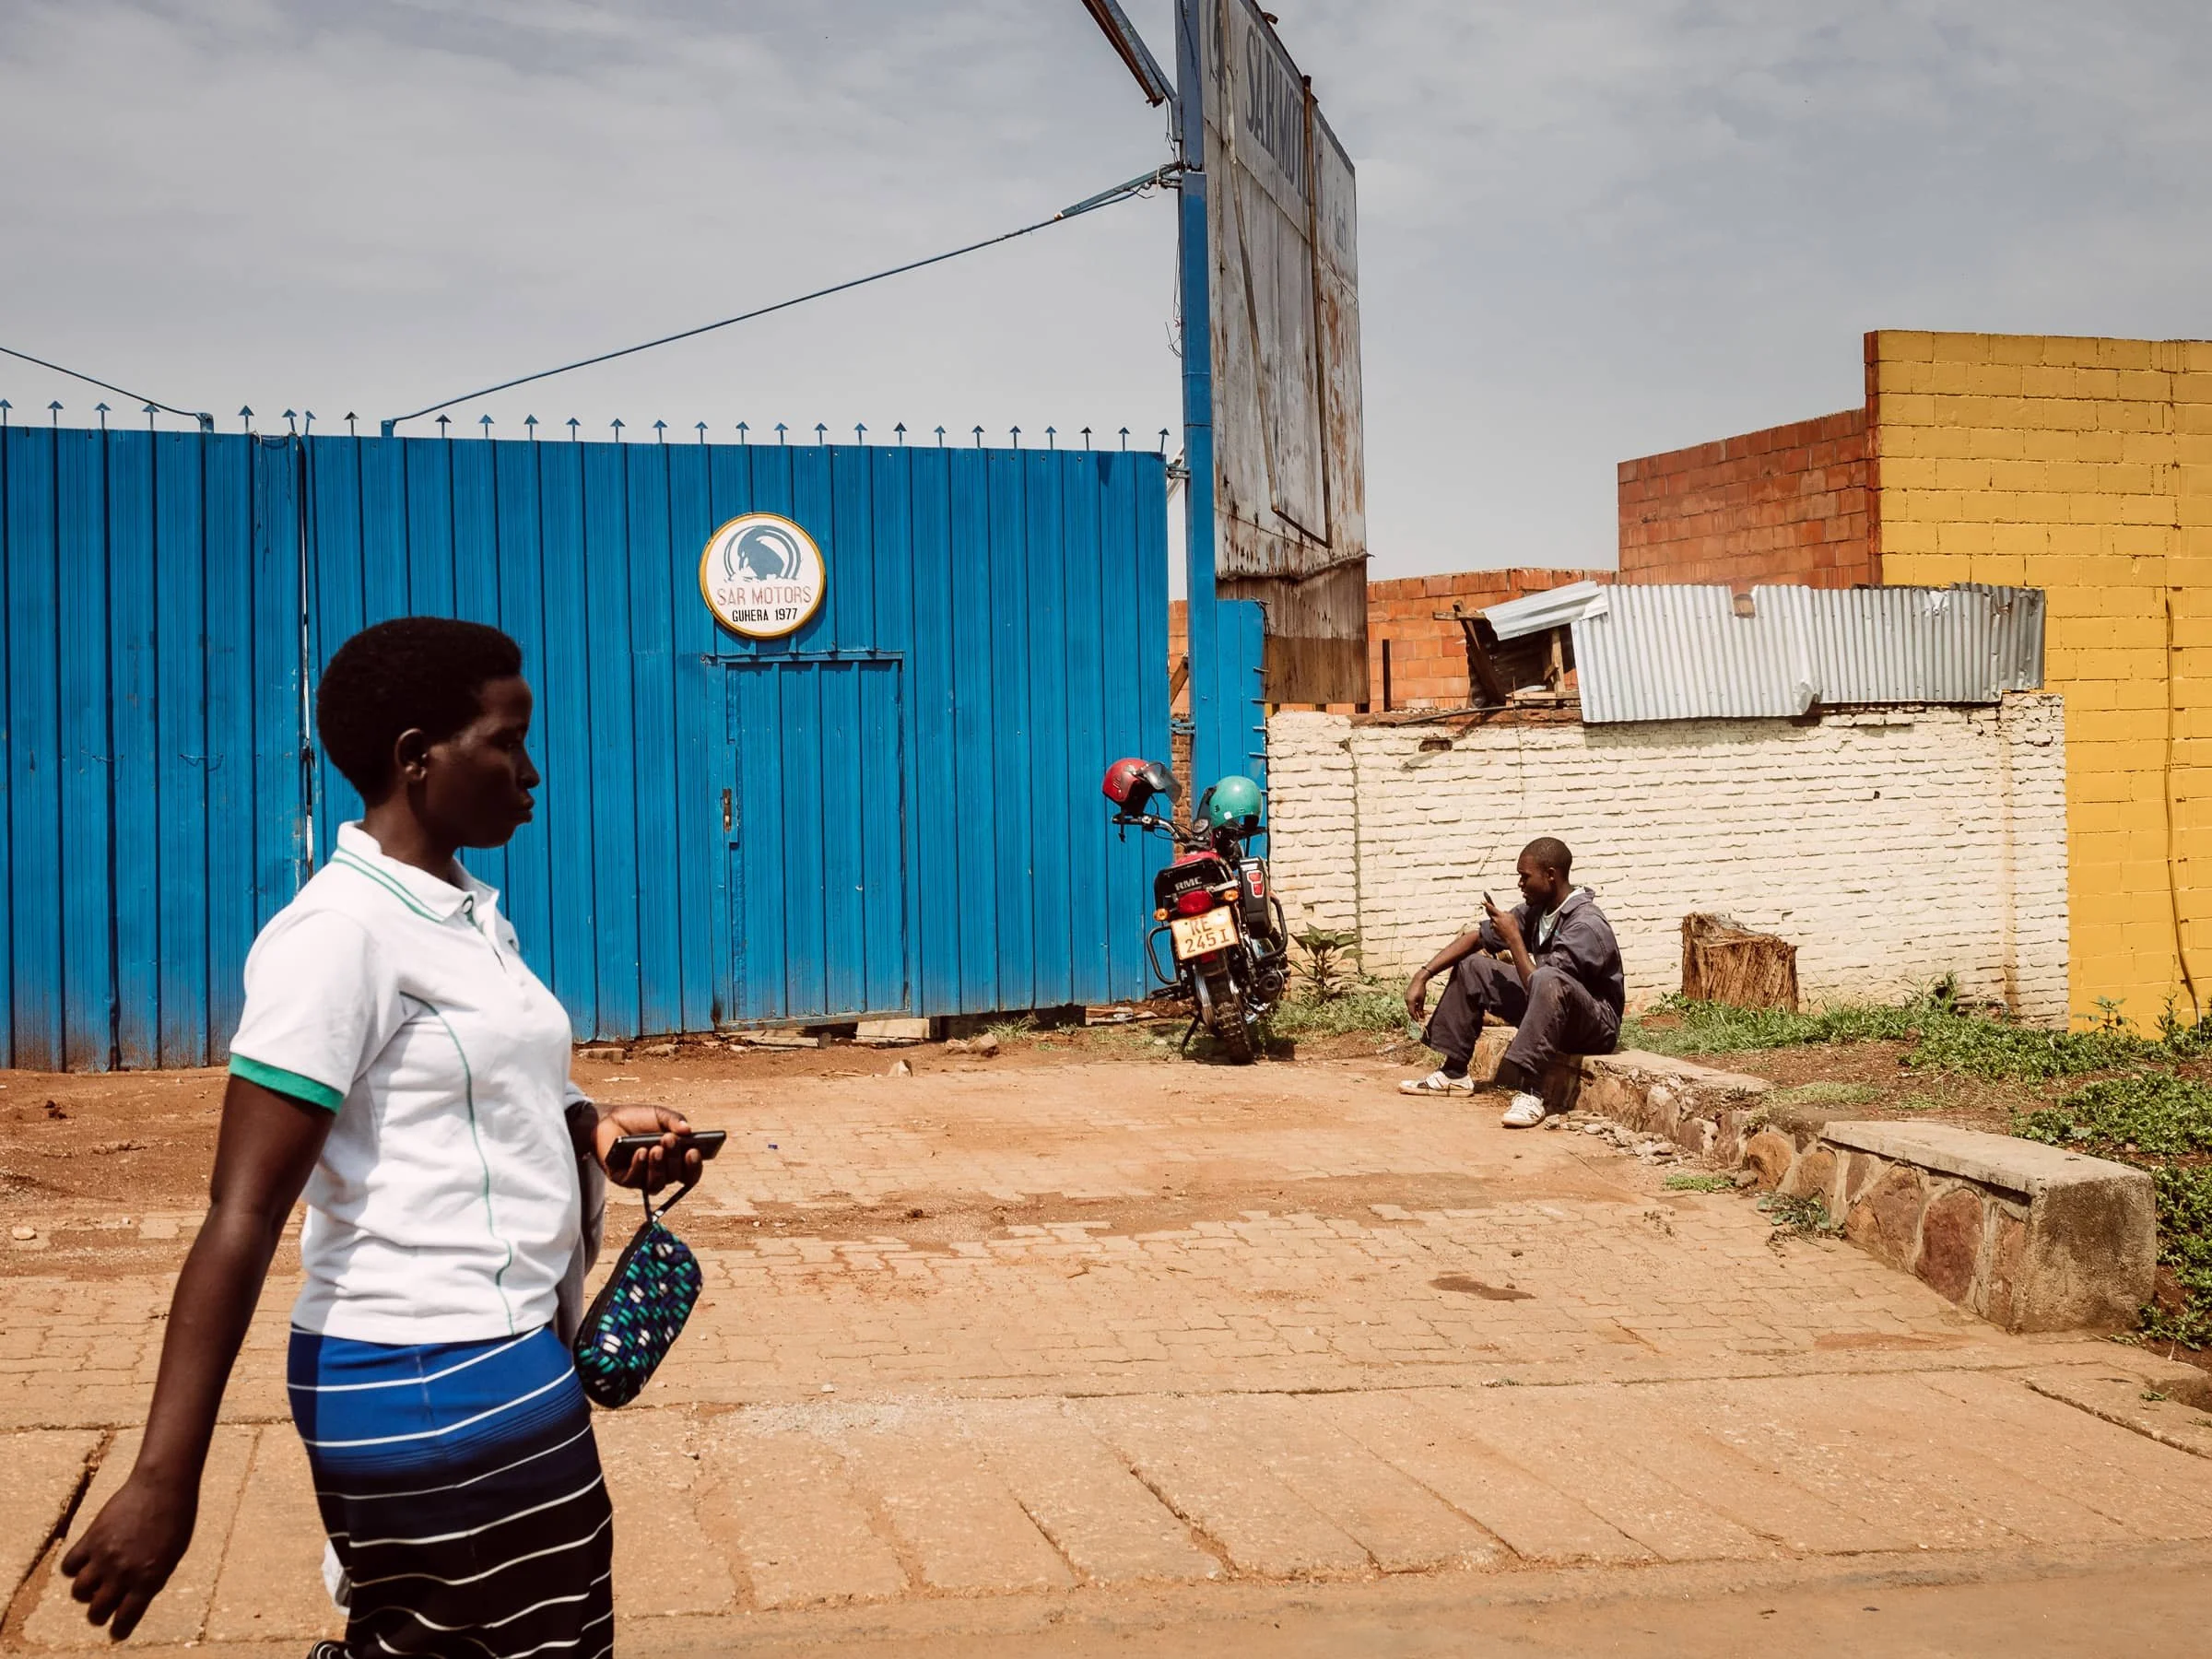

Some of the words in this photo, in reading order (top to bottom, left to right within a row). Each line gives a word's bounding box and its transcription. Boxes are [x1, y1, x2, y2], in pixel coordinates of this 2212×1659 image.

[1246, 24, 1275, 159] SAR
[717, 587, 746, 606] SAR
[752, 585, 812, 605] MOTORS
[732, 609, 769, 622] GUHERA
[775, 608, 797, 620] 1977
[1175, 877, 1202, 891] RMC
[1190, 918, 1212, 936] RE
